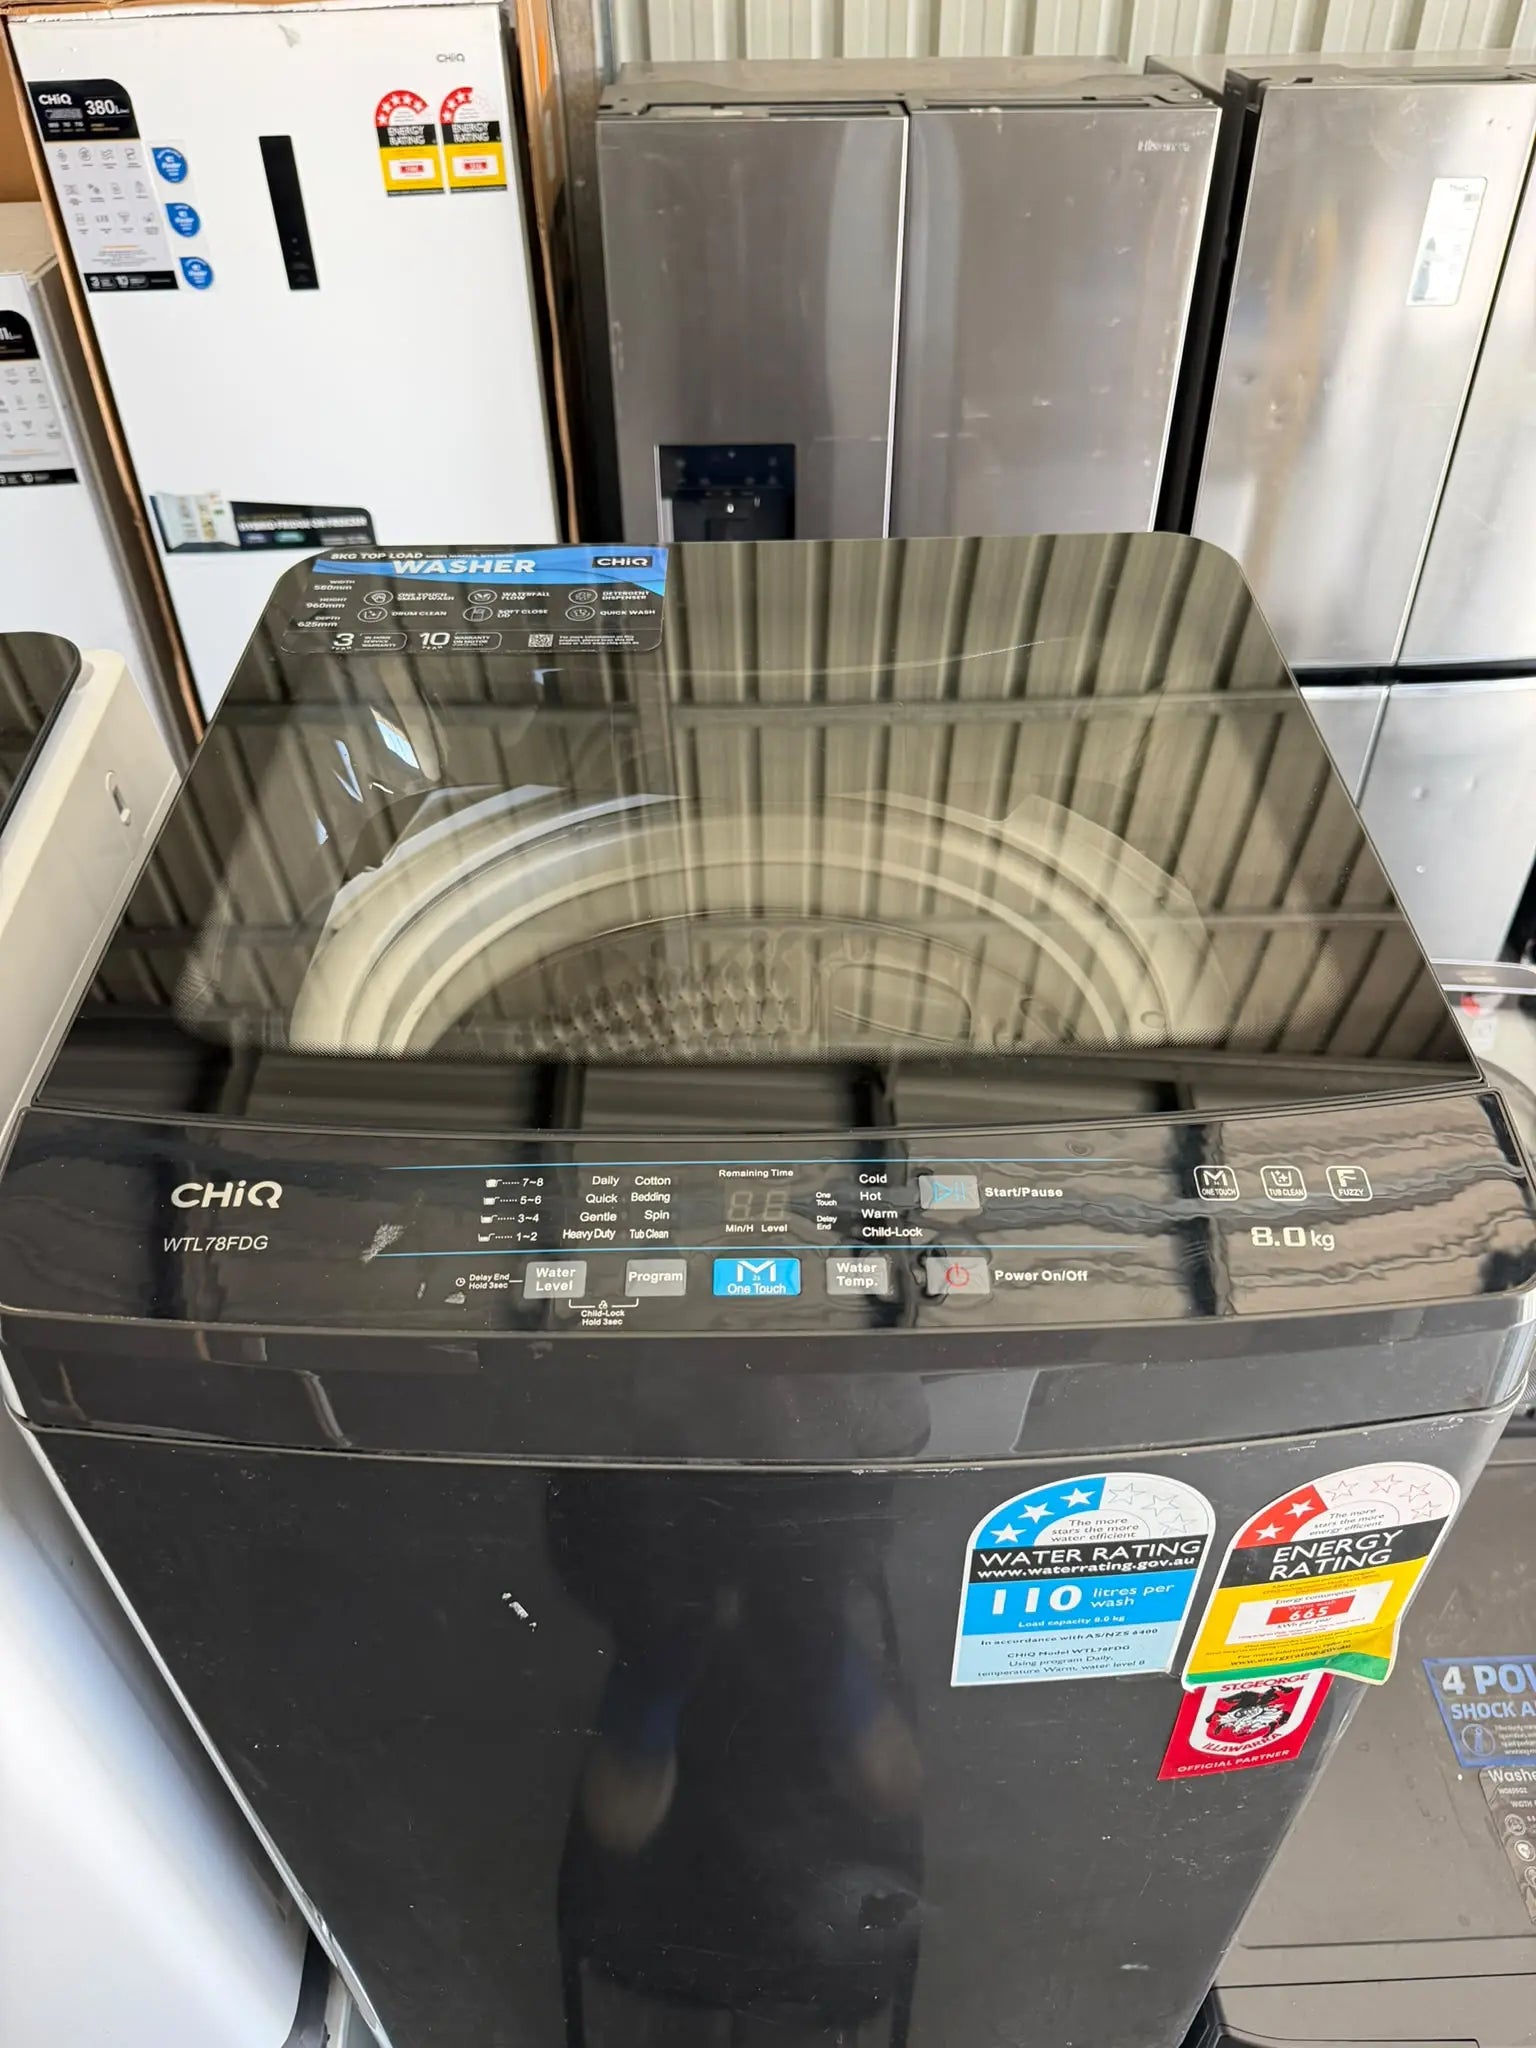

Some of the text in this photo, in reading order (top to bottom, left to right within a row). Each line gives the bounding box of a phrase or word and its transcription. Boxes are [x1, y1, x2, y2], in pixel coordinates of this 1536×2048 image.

[38, 94, 72, 106] CHiQ
[387, 125, 424, 137] ENERGY
[451, 122, 489, 134] ENERGY
[392, 558, 536, 575] WASHER
[597, 557, 649, 567] CHiQ
[332, 632, 356, 647] 3
[419, 632, 452, 647] 10
[718, 1168, 794, 1179] Remaining Time
[859, 1173, 888, 1184] Cold
[592, 1176, 620, 1187] Daily
[634, 1175, 671, 1186] Cotton
[171, 1180, 283, 1209] CHiQ
[631, 1192, 671, 1203] Bedding
[815, 1191, 831, 1199] One
[860, 1191, 882, 1201] Hot
[984, 1186, 1063, 1198] Start/Pause
[1201, 1188, 1237, 1196] ONE TOUCH
[1269, 1188, 1305, 1196] TUB CLEAN
[1338, 1188, 1364, 1196] FUZZY
[585, 1193, 618, 1204] Quick
[815, 1199, 837, 1207] Touch
[579, 1211, 618, 1222] Gentle
[644, 1209, 670, 1221] Spin
[816, 1215, 837, 1224] Delay
[861, 1209, 898, 1219] Warm
[725, 1224, 754, 1233] Min/H
[761, 1223, 788, 1233] Level
[816, 1223, 832, 1231] End
[862, 1226, 923, 1238] Child-Lock
[562, 1229, 616, 1241] Heavy Duty
[630, 1229, 669, 1239] Tub Clean
[1251, 1226, 1335, 1250] 8.0 kg
[164, 1235, 269, 1252] WTL78FDG
[535, 1267, 576, 1278] Water
[836, 1262, 878, 1273] Water
[469, 1273, 510, 1282] Delay End
[628, 1271, 683, 1283] Program
[836, 1275, 878, 1288] Temp.
[994, 1270, 1088, 1282] Power On/Off
[535, 1280, 573, 1291] Level
[727, 1283, 786, 1295] One Touch
[581, 1309, 625, 1317] Child-Lock
[582, 1318, 601, 1326] Hold
[1329, 1508, 1377, 1520] The more
[1314, 1514, 1385, 1529] stars the more
[1052, 1524, 1139, 1535] stars the more
[1309, 1521, 1382, 1537] energy efficient
[1051, 1531, 1136, 1543] water efficient
[1272, 1529, 1404, 1564] ENERGY
[980, 1540, 1202, 1567] WATER RATING
[977, 1556, 1196, 1579] www.waterrating.gov.au
[1269, 1548, 1393, 1581] RATING
[1093, 1583, 1175, 1598] litres per
[992, 1584, 1083, 1615] 110
[1090, 1597, 1135, 1608] wash
[1289, 1606, 1330, 1622] 665
[1018, 1620, 1044, 1628] Load
[1048, 1617, 1092, 1628] capacity
[1112, 1614, 1126, 1623] kg
[993, 1635, 1057, 1646] accordance
[1060, 1633, 1085, 1641] with
[1085, 1630, 1130, 1640] AS/NZS
[1009, 1659, 1037, 1668] Using
[1039, 1657, 1084, 1668] program
[978, 1667, 1041, 1678] temperature
[1081, 1663, 1110, 1671] water
[1113, 1660, 1137, 1668] level
[1442, 1666, 1466, 1695] 4
[1450, 1701, 1517, 1720] SHOCK
[1201, 1732, 1283, 1752] ILLAWARRA
[1177, 1749, 1290, 1773] OFFICIAL PARTNER
